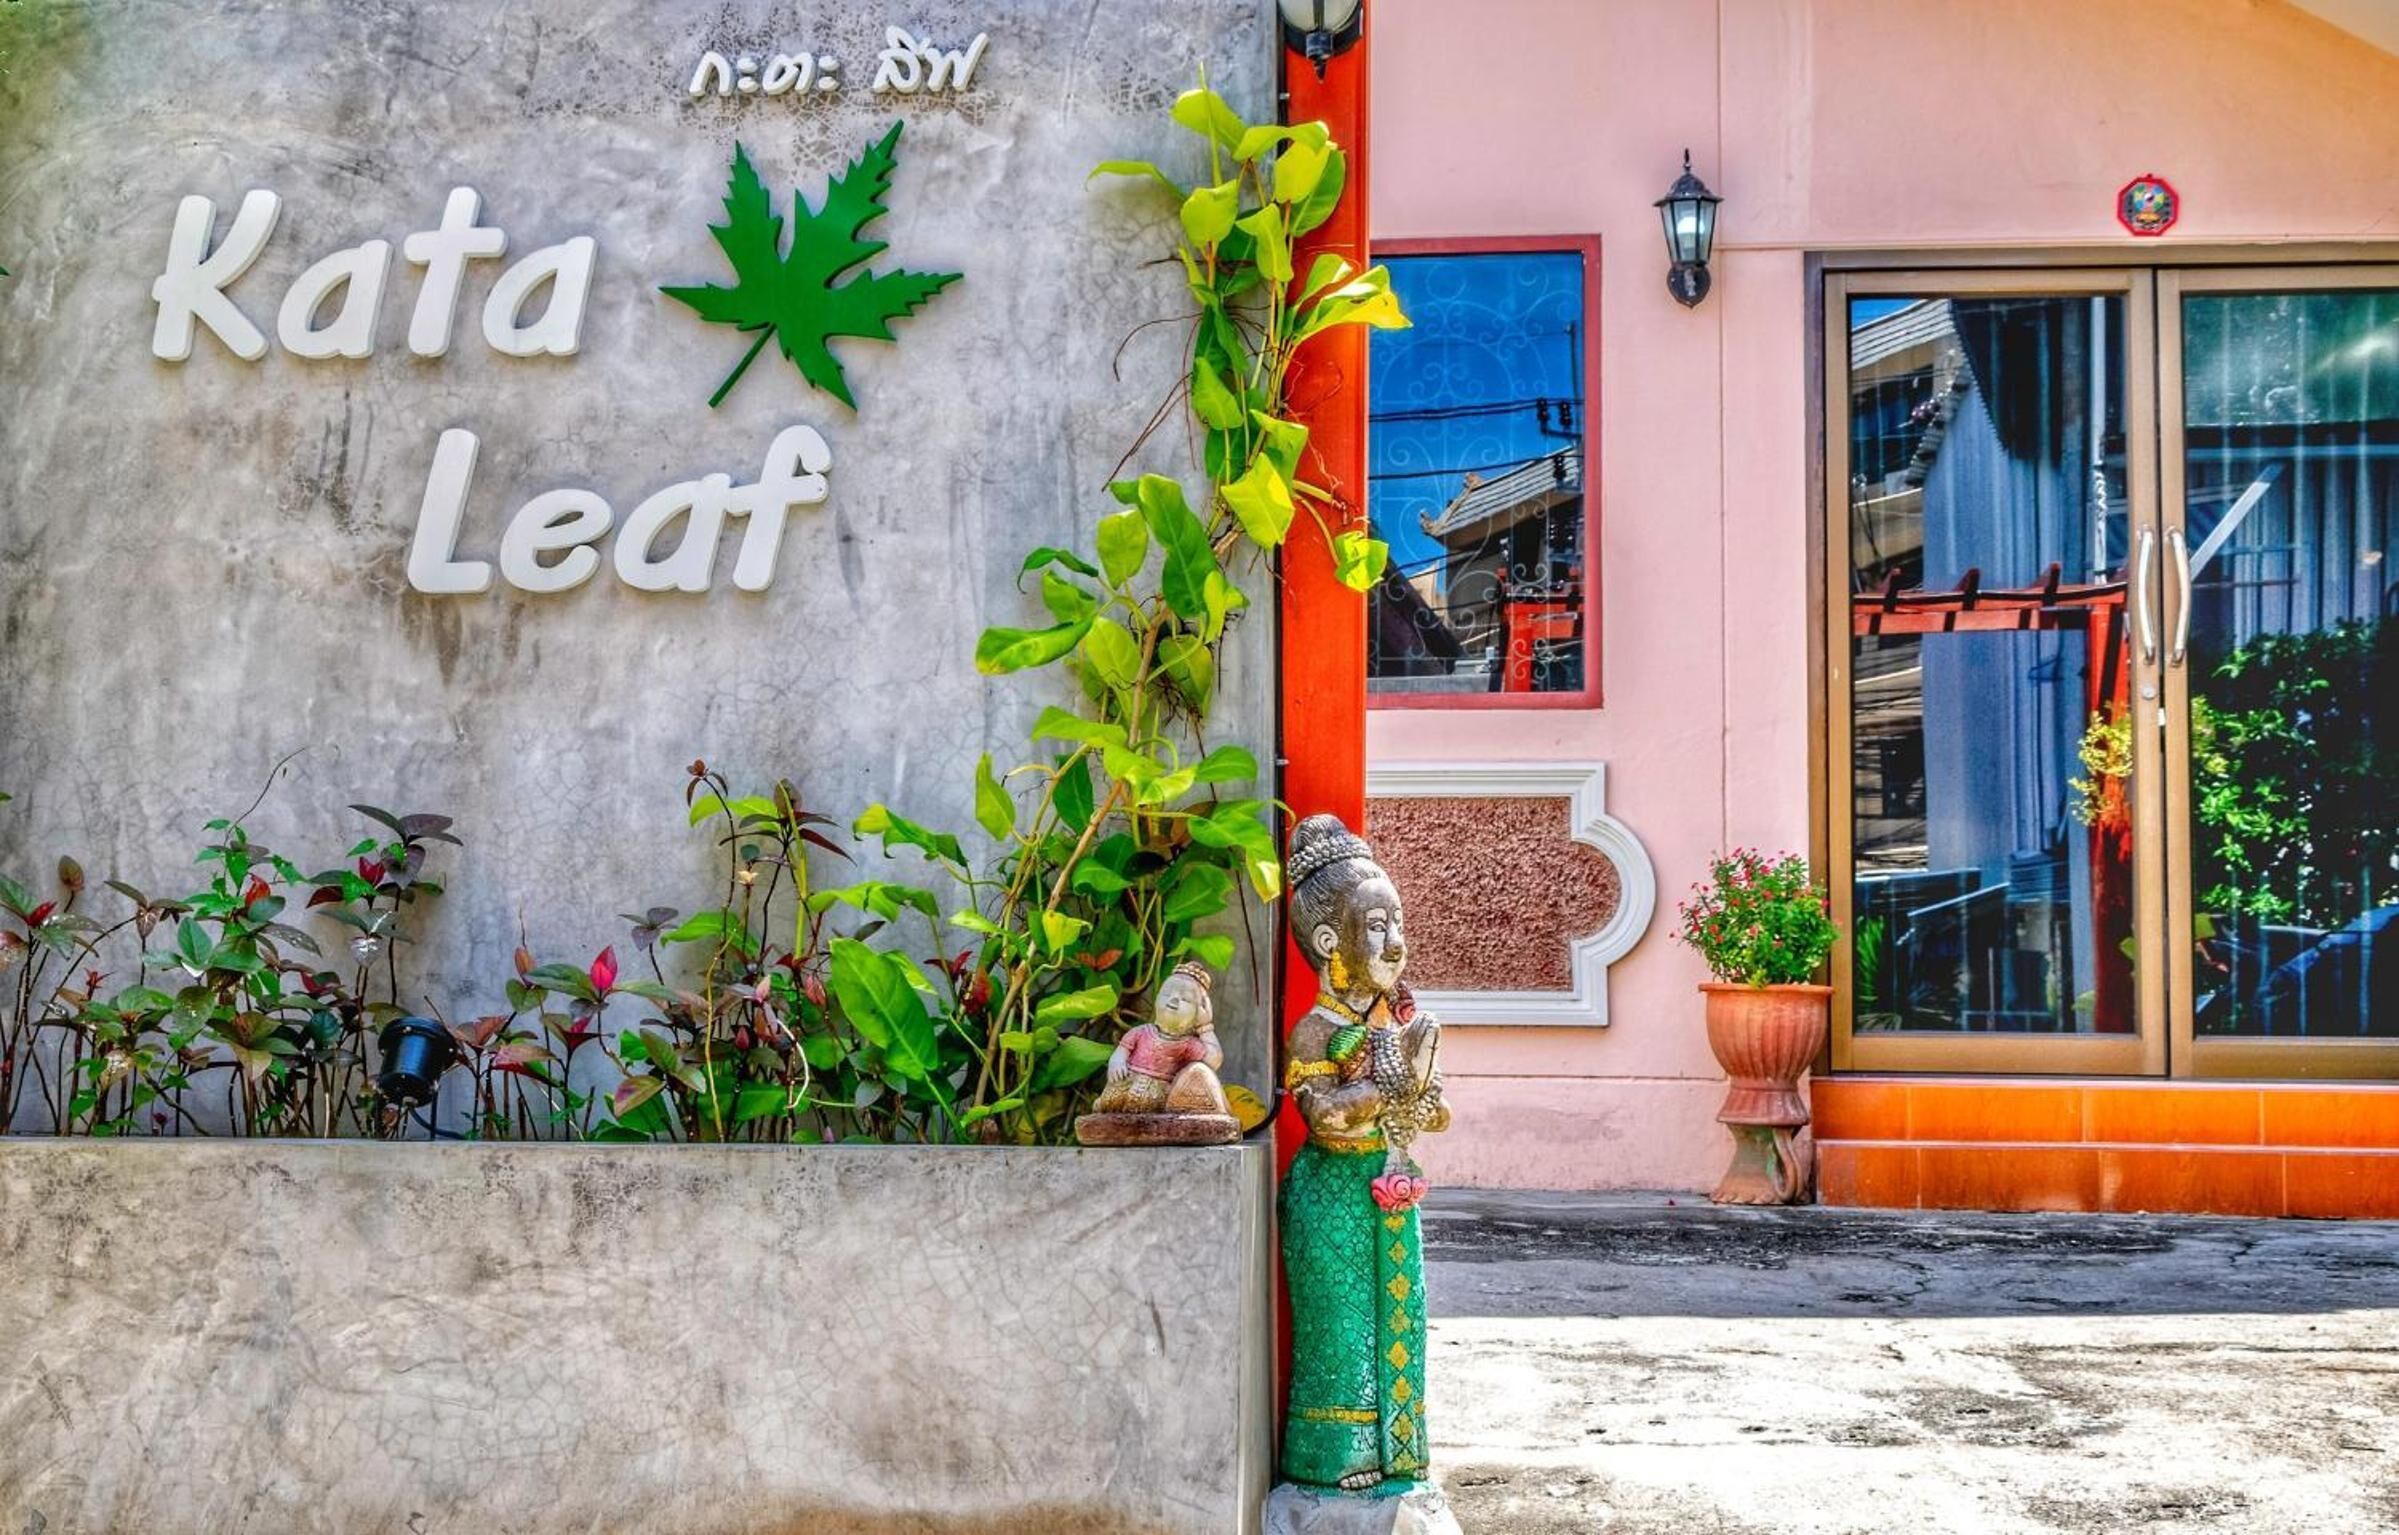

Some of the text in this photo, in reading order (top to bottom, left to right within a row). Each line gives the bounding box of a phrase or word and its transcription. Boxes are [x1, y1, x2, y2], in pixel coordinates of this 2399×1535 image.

[689, 50, 841, 97] กะตะ
[151, 186, 596, 361] Kata
[407, 424, 832, 594] Leaf
